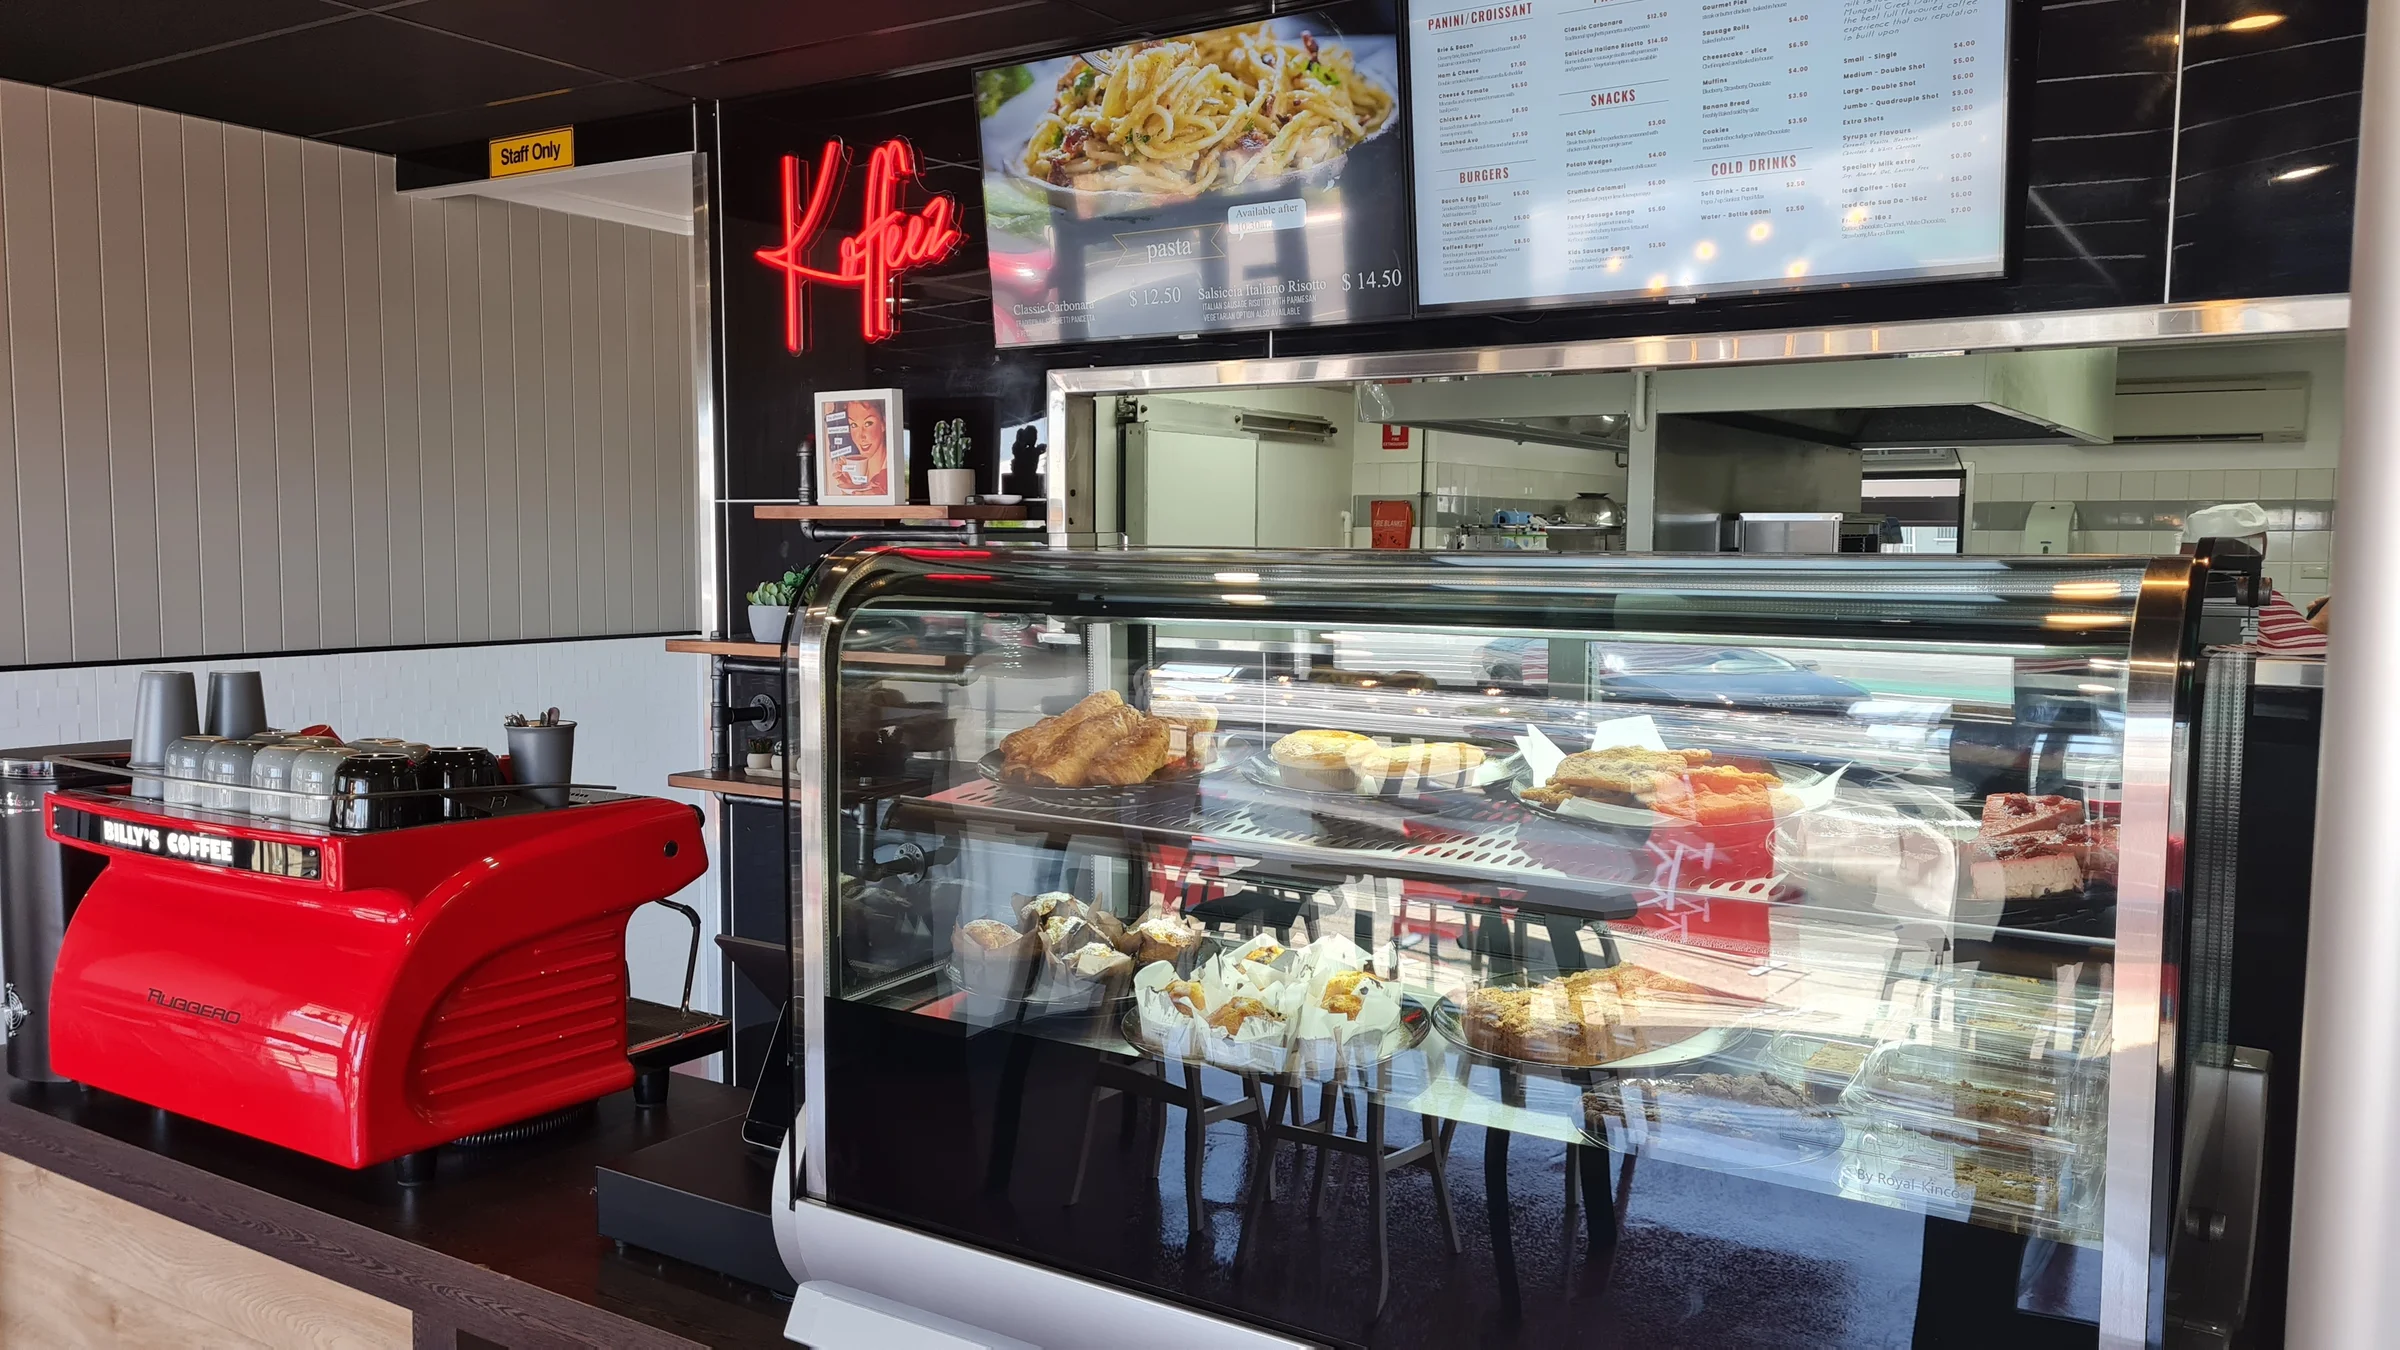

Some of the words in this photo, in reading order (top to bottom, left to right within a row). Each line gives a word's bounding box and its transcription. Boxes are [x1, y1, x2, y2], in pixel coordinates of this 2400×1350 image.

[1702, 2, 1732, 11] Gourmet
[1861, 14, 1880, 22] best
[1901, 5, 1943, 15] flavoured
[1885, 2, 1910, 10] Creek
[1428, 3, 1532, 31] PANINI/CROISSANT
[1564, 25, 1587, 33] Classic
[1589, 20, 1623, 29] Carbonara
[1647, 12, 1668, 20] $12.50
[1844, 21, 1890, 33] experience
[1932, 8, 1978, 20] reputation
[1703, 28, 1731, 36] Sausage
[1789, 15, 1809, 23] $4.00
[1856, 31, 1874, 40] built
[1878, 29, 1899, 37] upon
[1565, 48, 1593, 57] Salsiccia
[1595, 44, 1619, 53] Italiano
[1621, 40, 1644, 49] Risotto
[1648, 36, 1668, 45] $14.50
[1844, 56, 1865, 64] Small
[1874, 51, 1897, 60] Single
[1954, 40, 1976, 48] $4.00
[1702, 51, 1744, 61] Cheesecake
[1843, 70, 1873, 79] Medium
[1881, 66, 1906, 75] Double
[1953, 56, 1975, 65] $5.00
[1703, 78, 1728, 86] Muffins
[1789, 66, 1809, 74] $4.00
[1872, 83, 1898, 91] Double
[1591, 89, 1636, 107] SNACKS
[1703, 101, 1728, 110] Banana
[1730, 99, 1750, 107] Bread
[1843, 102, 1868, 110] Jumbo
[1440, 115, 1463, 123] Chicken
[1843, 118, 1862, 126] Extra
[1843, 132, 1868, 141] Syrups
[1880, 128, 1911, 137] Flavours
[501, 145, 529, 165] Staff
[532, 141, 561, 161] Only
[1588, 158, 1612, 166] Wedges
[1712, 161, 1743, 176] COLD
[1749, 155, 1797, 172] DRINKS
[1842, 162, 1877, 172] Specialty
[1878, 158, 1894, 167] Milk
[1460, 167, 1509, 184] BURGERS
[1567, 187, 1596, 195] Crumbed
[1597, 183, 1626, 192] Calamari
[1842, 186, 1858, 194] Iced
[1860, 184, 1883, 192] Coffee
[1236, 205, 1276, 219] Available
[1278, 204, 1298, 214] after
[1842, 200, 1858, 209] Iced
[1859, 199, 1876, 207] Cafe
[1567, 213, 1585, 221] Fancy
[1587, 211, 1614, 219] Sausage
[1146, 238, 1192, 264] pasta
[1198, 284, 1243, 300] Salsiccia
[1246, 282, 1285, 296] Italiano
[1288, 279, 1326, 292] Risotto
[1342, 273, 1351, 292] $
[1358, 269, 1402, 290] 14.50
[1014, 303, 1045, 315] Classic
[1048, 301, 1095, 313] Carbonara
[1129, 290, 1138, 308] $
[1144, 287, 1181, 306] 12.50
[1202, 302, 1223, 311] ITALIAN
[1249, 299, 1271, 308] RISOTTO
[1272, 297, 1286, 305] WITH
[1287, 296, 1317, 304] PARMESAN
[1271, 307, 1300, 317] AVAILABLE
[103, 821, 160, 850] BILLY'S
[167, 833, 233, 862] COFFEE
[1857, 1169, 1873, 1184] By
